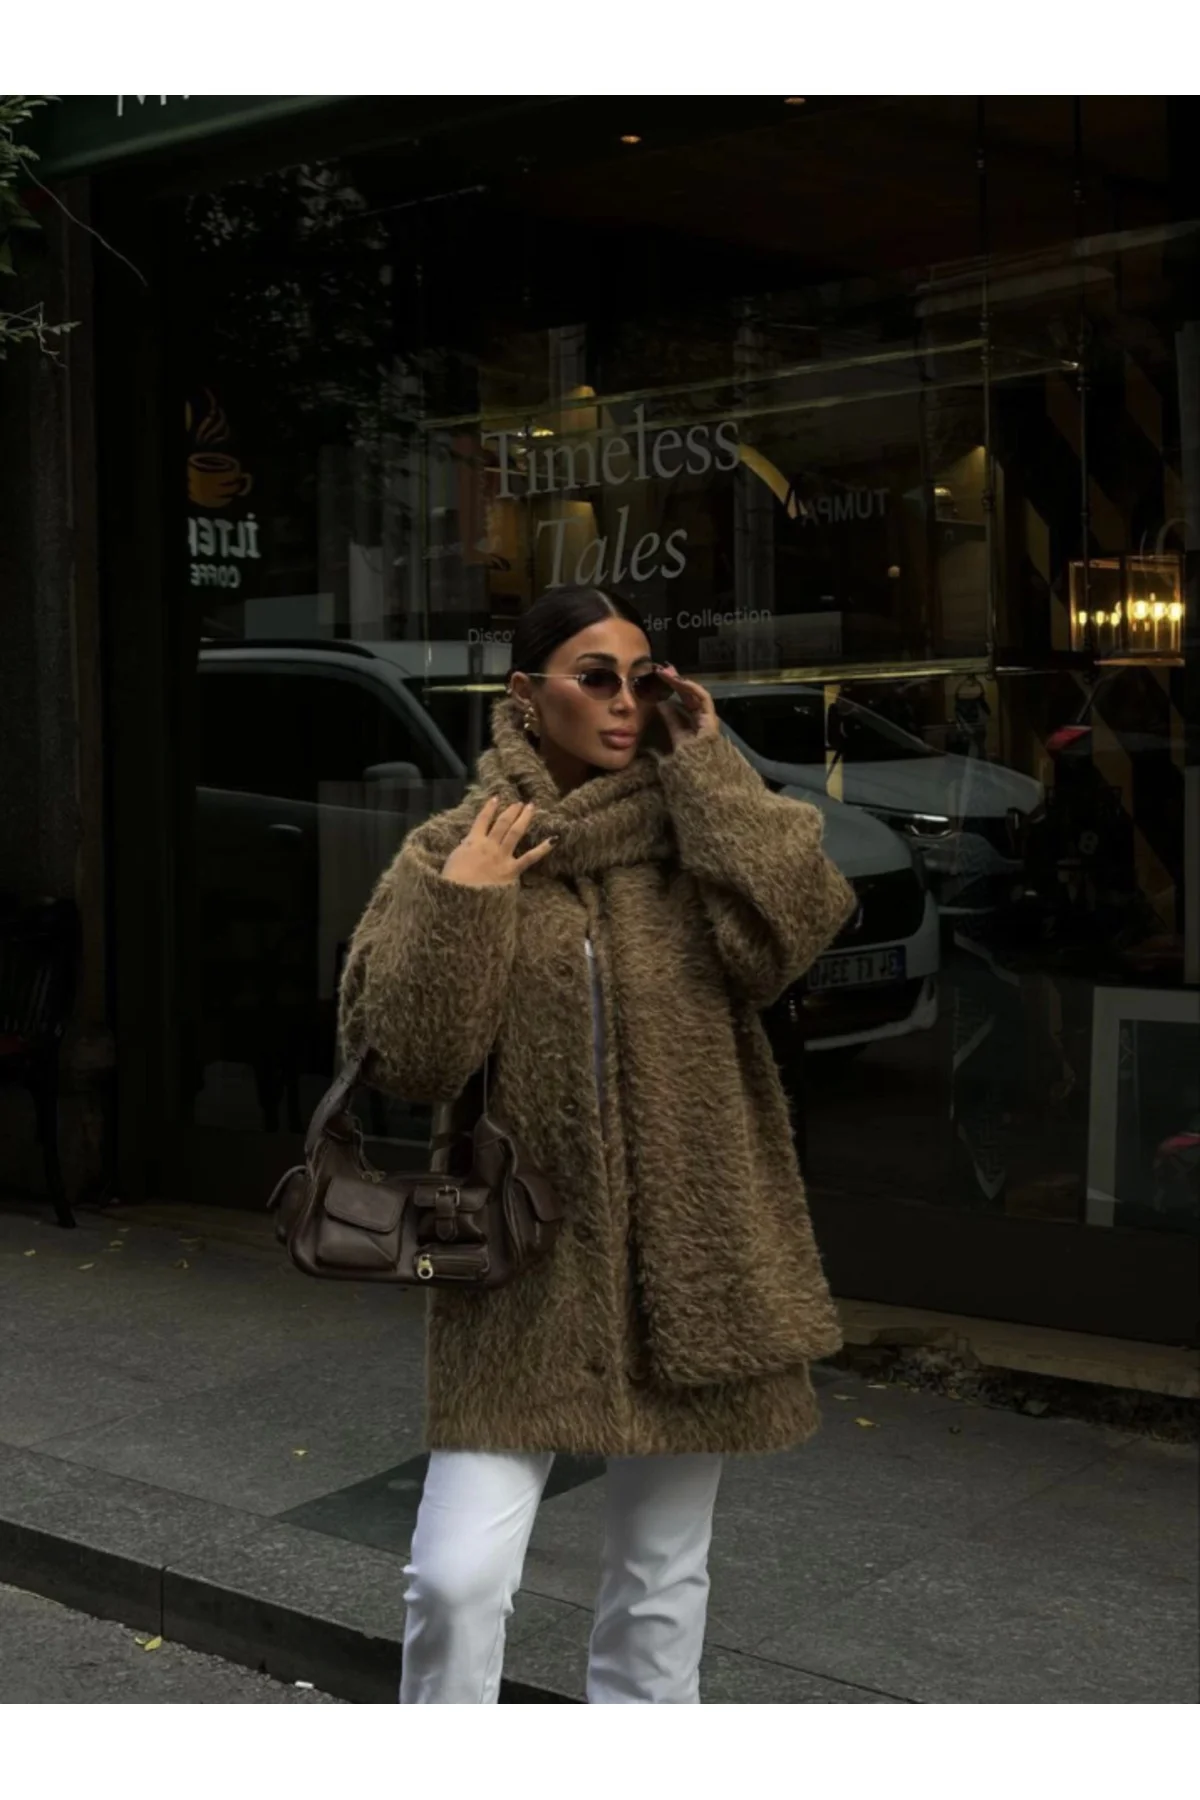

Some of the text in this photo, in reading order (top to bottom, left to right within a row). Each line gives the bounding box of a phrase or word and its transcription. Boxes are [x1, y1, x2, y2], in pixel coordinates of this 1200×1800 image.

[480, 403, 741, 499] Timeless
[536, 503, 689, 590] Tales
[467, 627, 516, 645] Disco
[676, 606, 773, 630] Collection
